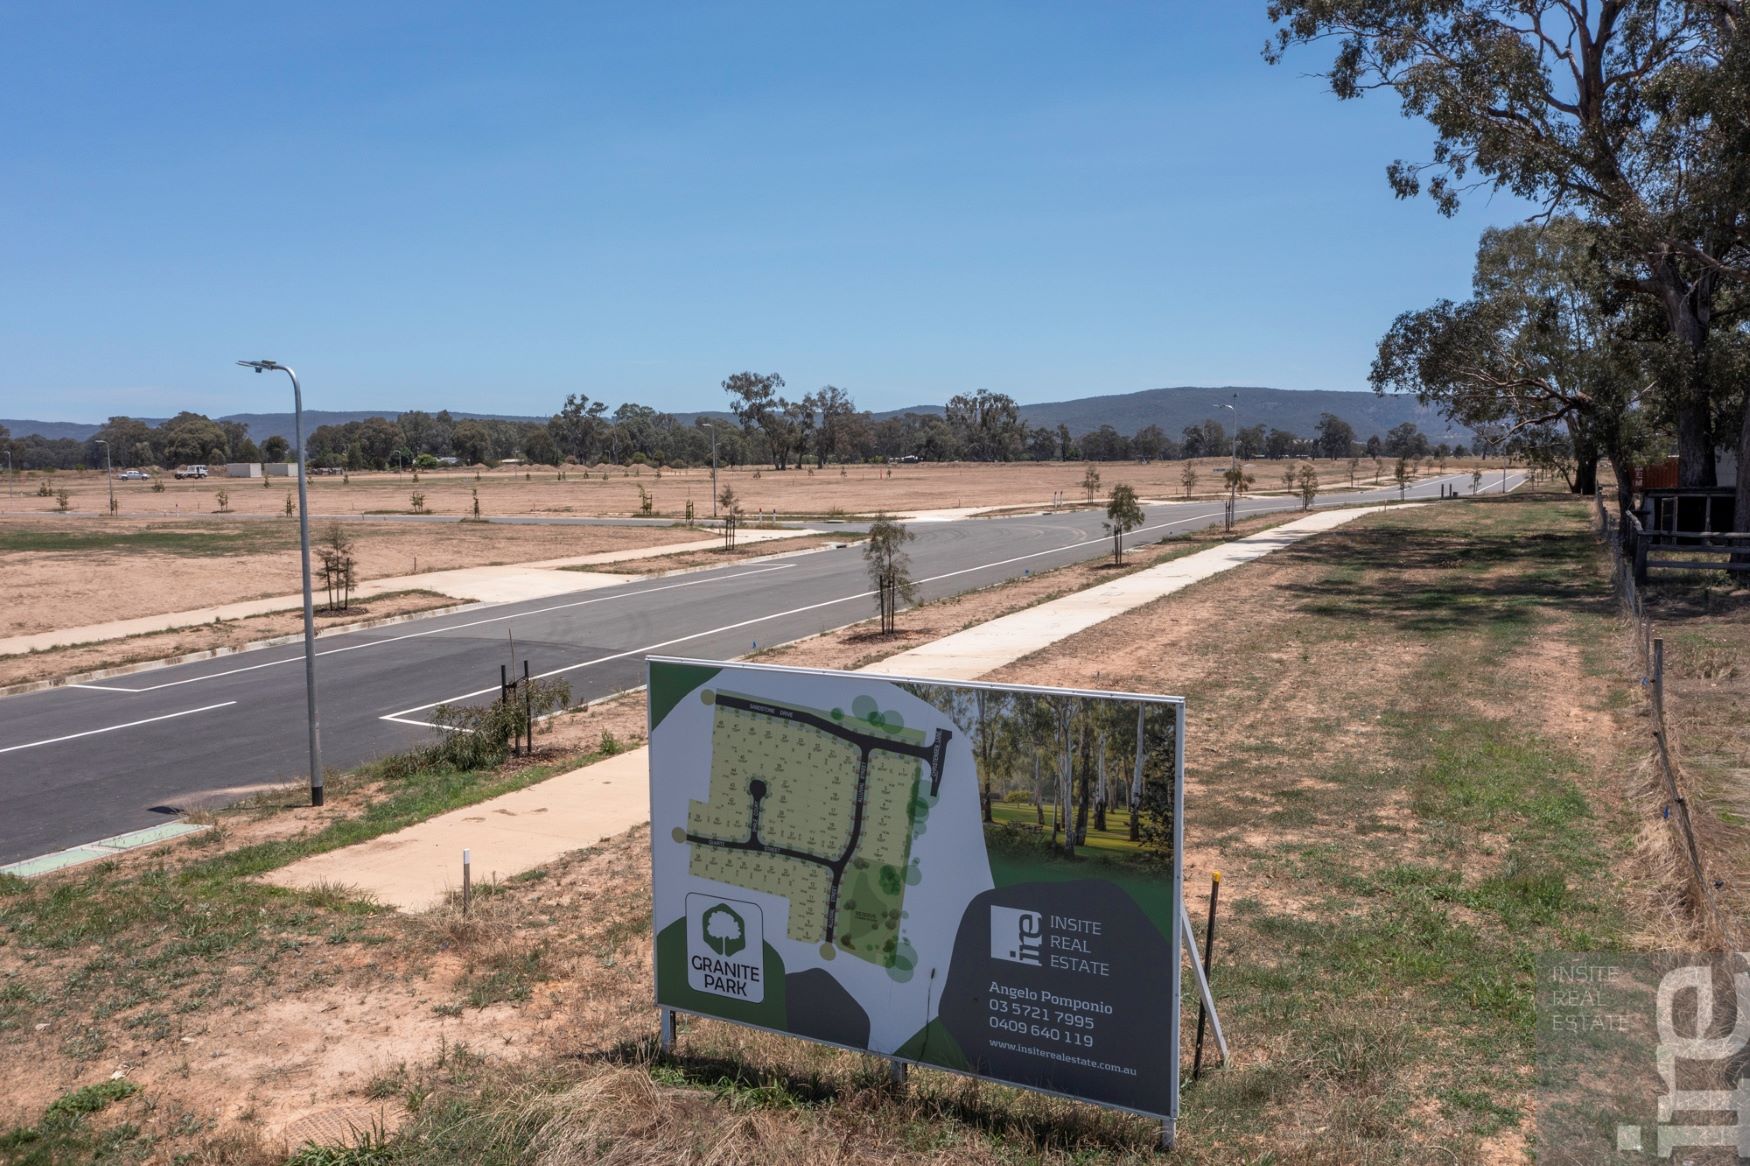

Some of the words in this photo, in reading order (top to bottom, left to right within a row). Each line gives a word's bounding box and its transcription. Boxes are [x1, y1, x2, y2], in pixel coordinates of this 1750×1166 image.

[1049, 914, 1103, 936] INSITE
[1049, 935, 1092, 954] REAL
[691, 955, 760, 983] GRANITE
[1049, 955, 1110, 977] ESTATE
[703, 973, 748, 997] PARK
[989, 981, 1037, 1001] Angelo
[1041, 991, 1113, 1015] Pomponio
[989, 999, 1008, 1013] 03
[1012, 1003, 1050, 1021] 5721
[1055, 1011, 1094, 1029] 7995
[989, 1016, 1027, 1034] 0409
[1031, 1025, 1060, 1041] 640
[1064, 1031, 1094, 1048] 119
[989, 1040, 1137, 1076] www.insiterealestate.com.au
